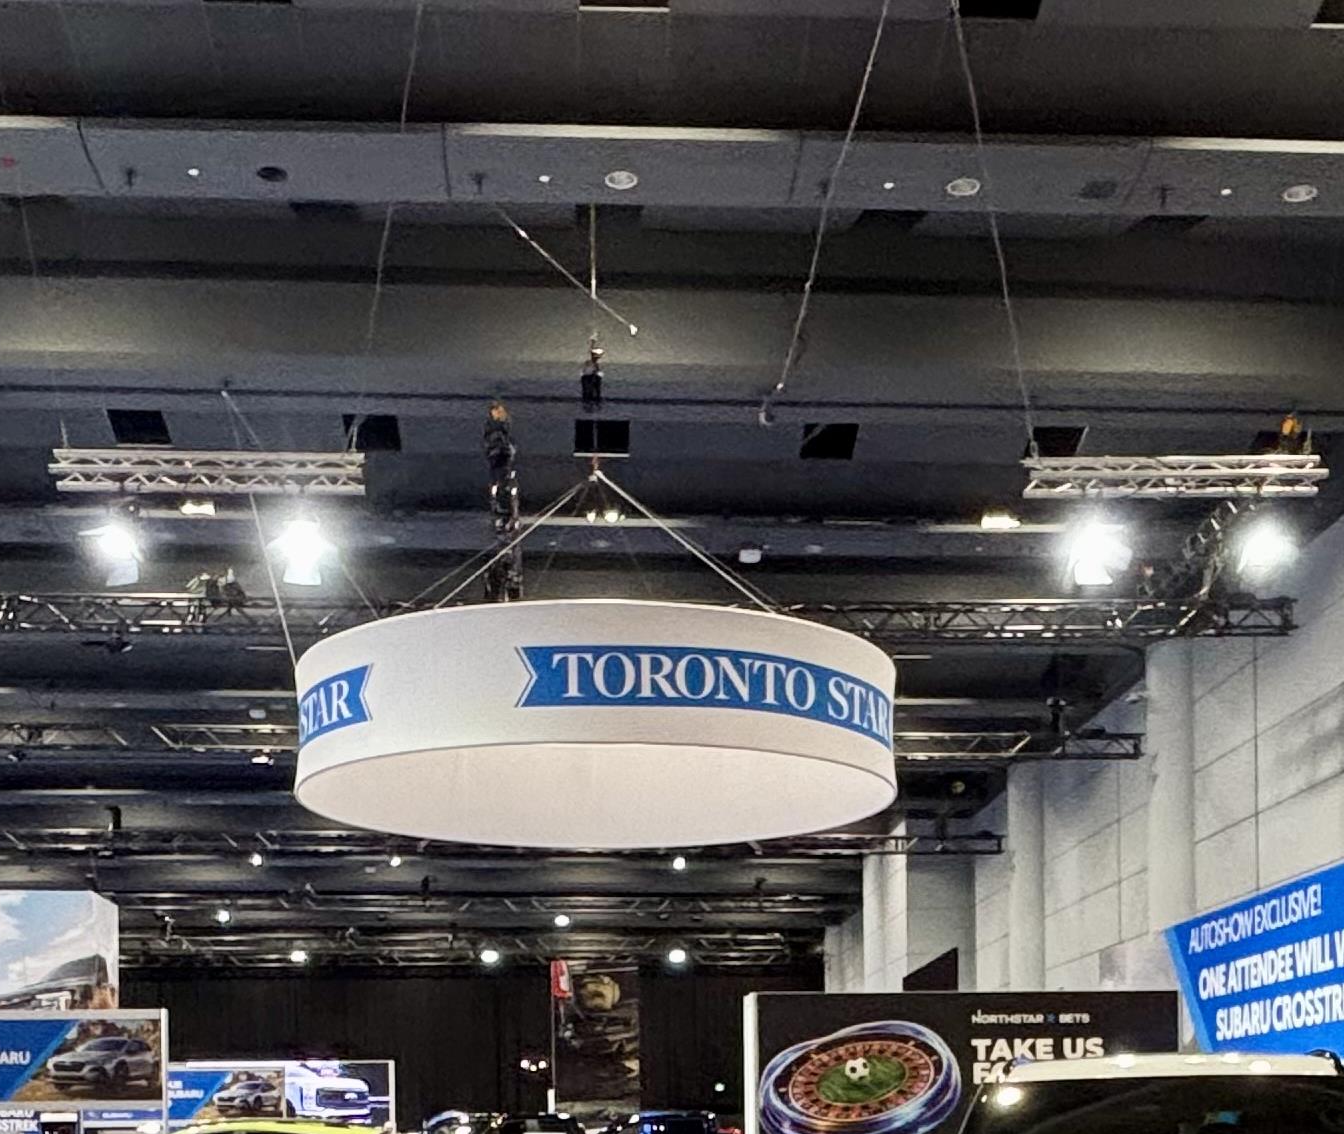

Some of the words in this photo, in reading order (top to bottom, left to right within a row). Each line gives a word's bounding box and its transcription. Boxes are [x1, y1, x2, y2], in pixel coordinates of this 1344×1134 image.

[300, 680, 353, 742] STAR
[551, 651, 816, 711] TORONTO
[827, 676, 889, 741] STAR
[1188, 908, 1253, 955] AUTOSHOW
[1254, 883, 1322, 936] EXCLUSIVE!
[1198, 962, 1227, 1000] ONE
[1227, 944, 1294, 994] ATTENDEE
[1294, 933, 1334, 977] WILL
[972, 1009, 1045, 1024] NORTHSTAR
[1059, 1013, 1090, 1024] BETS
[1215, 998, 1273, 1042] SUBARU
[971, 1037, 1055, 1061] TAKE
[1062, 1036, 1105, 1060] US
